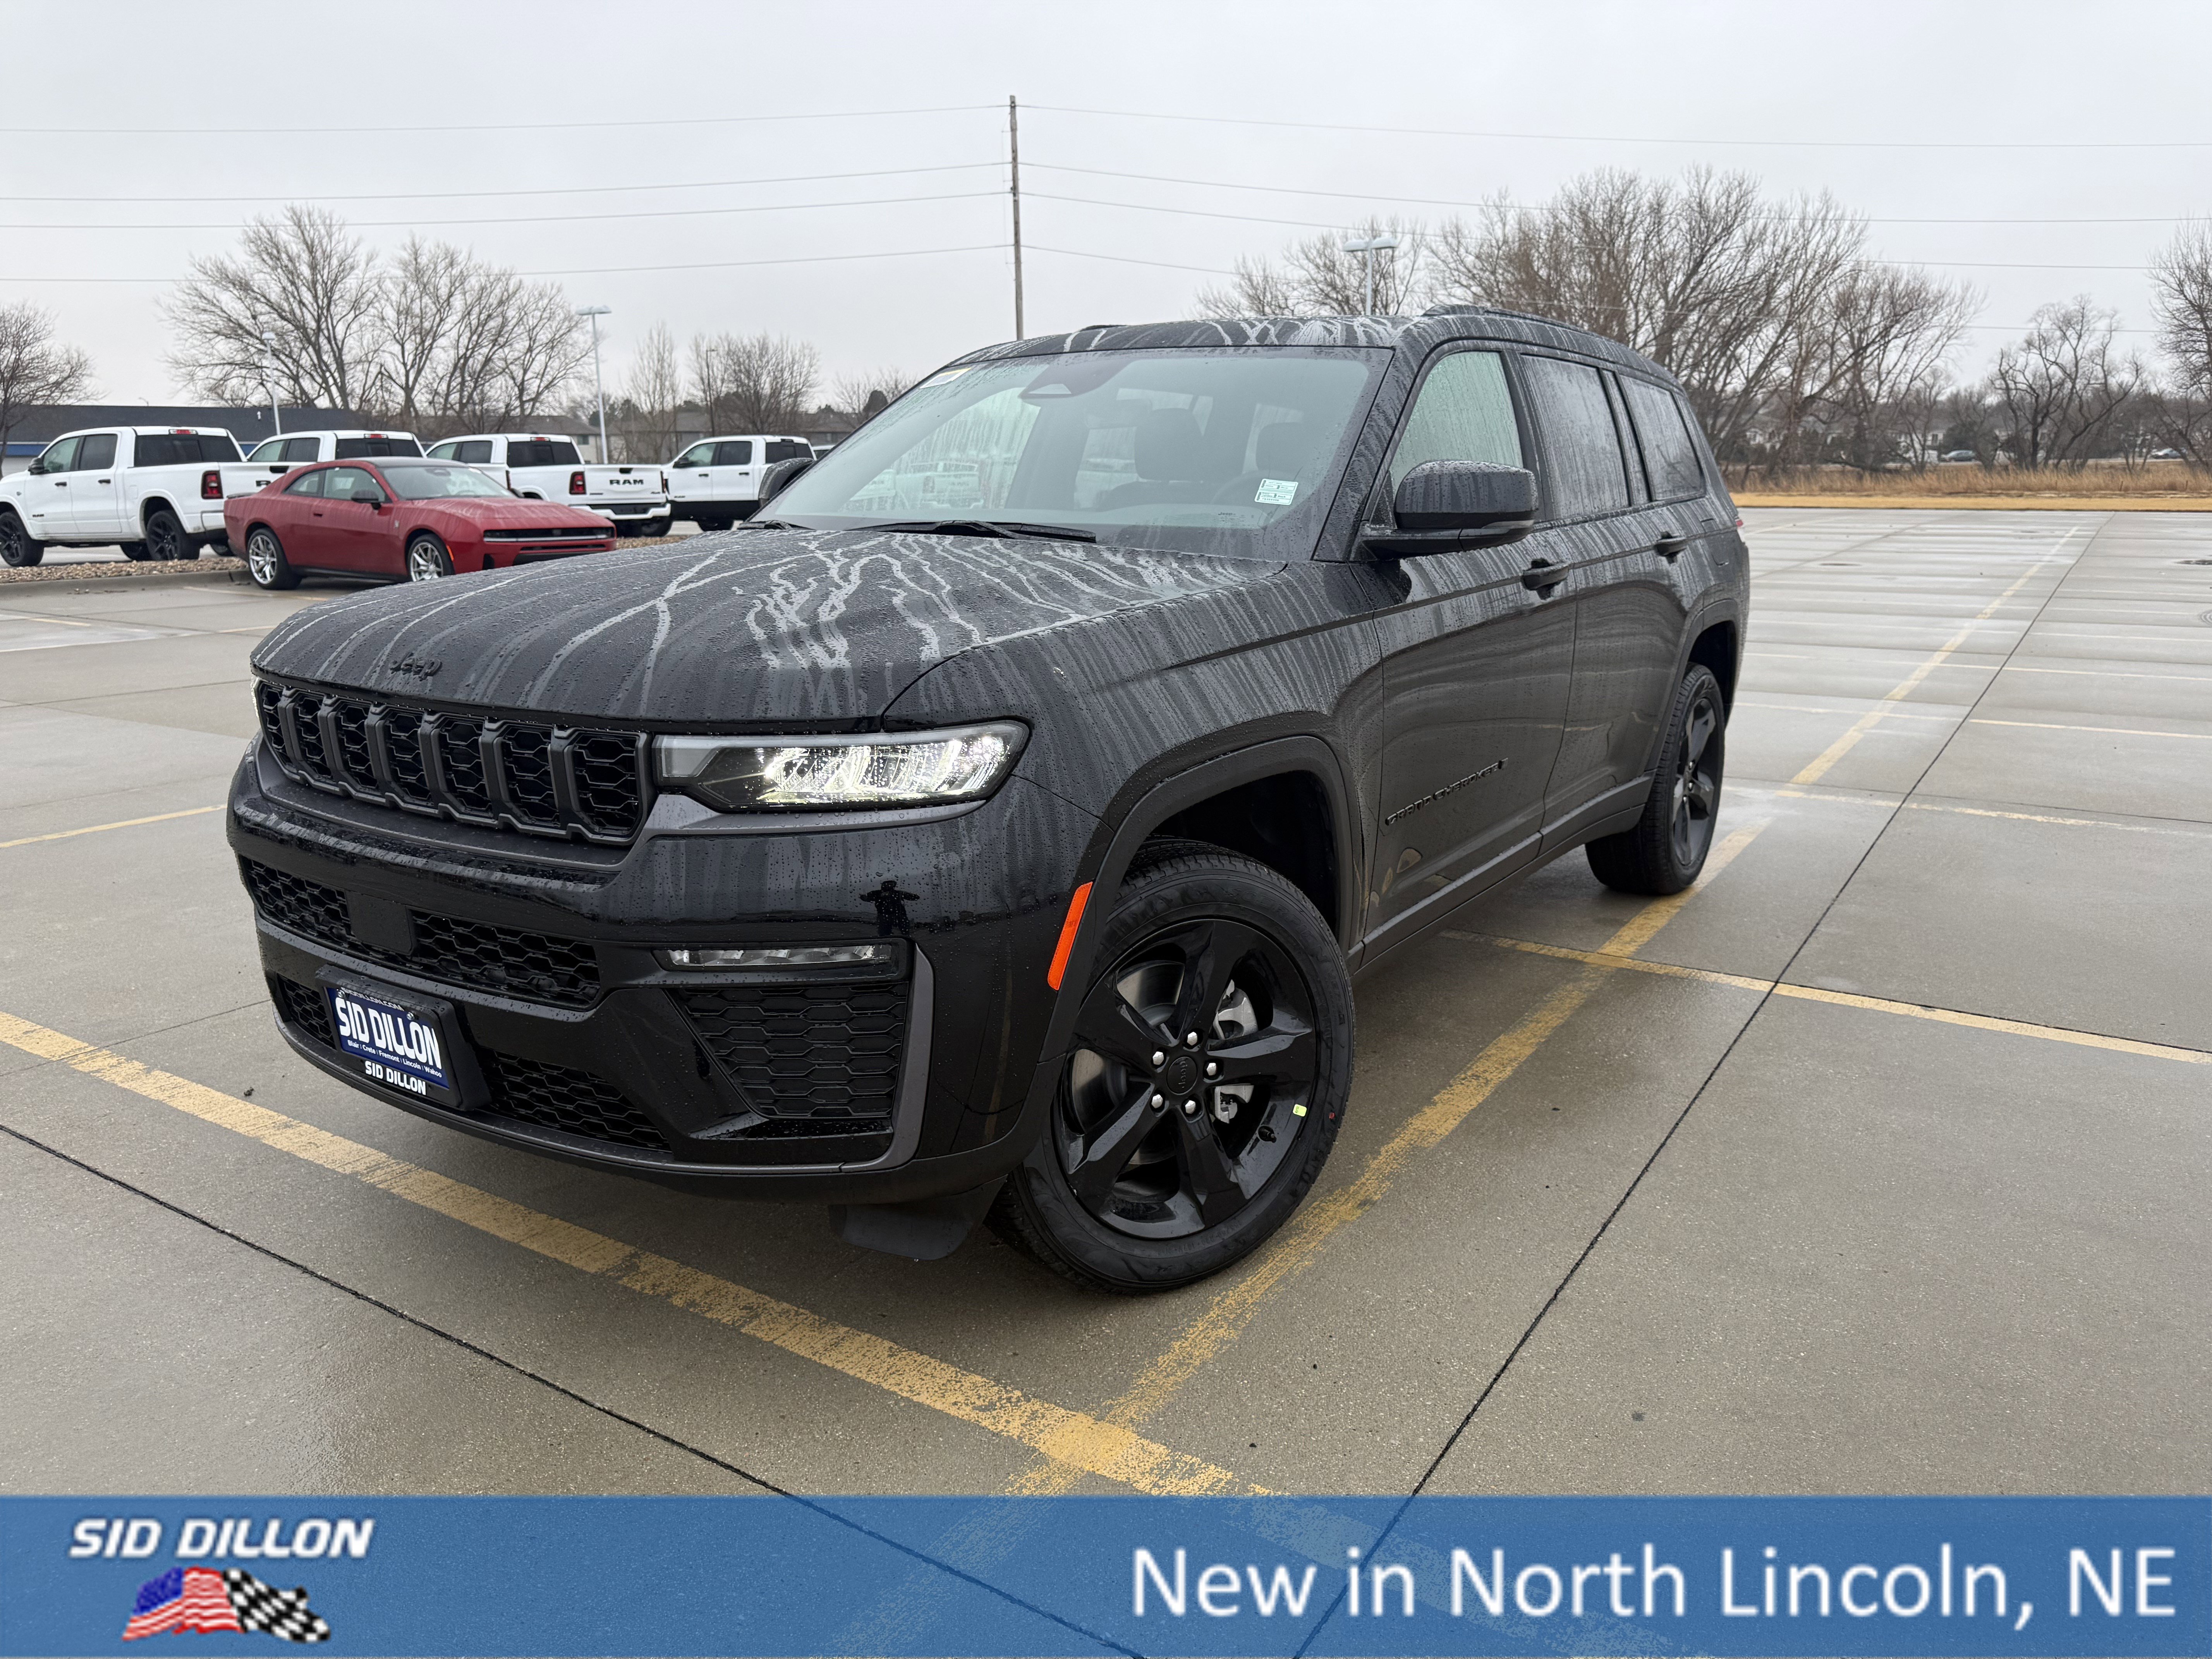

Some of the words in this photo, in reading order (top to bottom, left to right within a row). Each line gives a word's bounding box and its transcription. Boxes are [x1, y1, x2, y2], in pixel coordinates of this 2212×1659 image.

[389, 651, 443, 682] Jeep
[335, 997, 369, 1043] SID
[368, 1008, 442, 1070] DILLON
[347, 1040, 359, 1048] Blair
[362, 1044, 376, 1054] Crete
[379, 1050, 400, 1062] Fremont
[403, 1058, 421, 1070] Lincoln
[424, 1066, 442, 1078] Wahoo
[1178, 1060, 1188, 1089] Jeep
[365, 1060, 383, 1079] SID
[386, 1068, 426, 1096] DILLON
